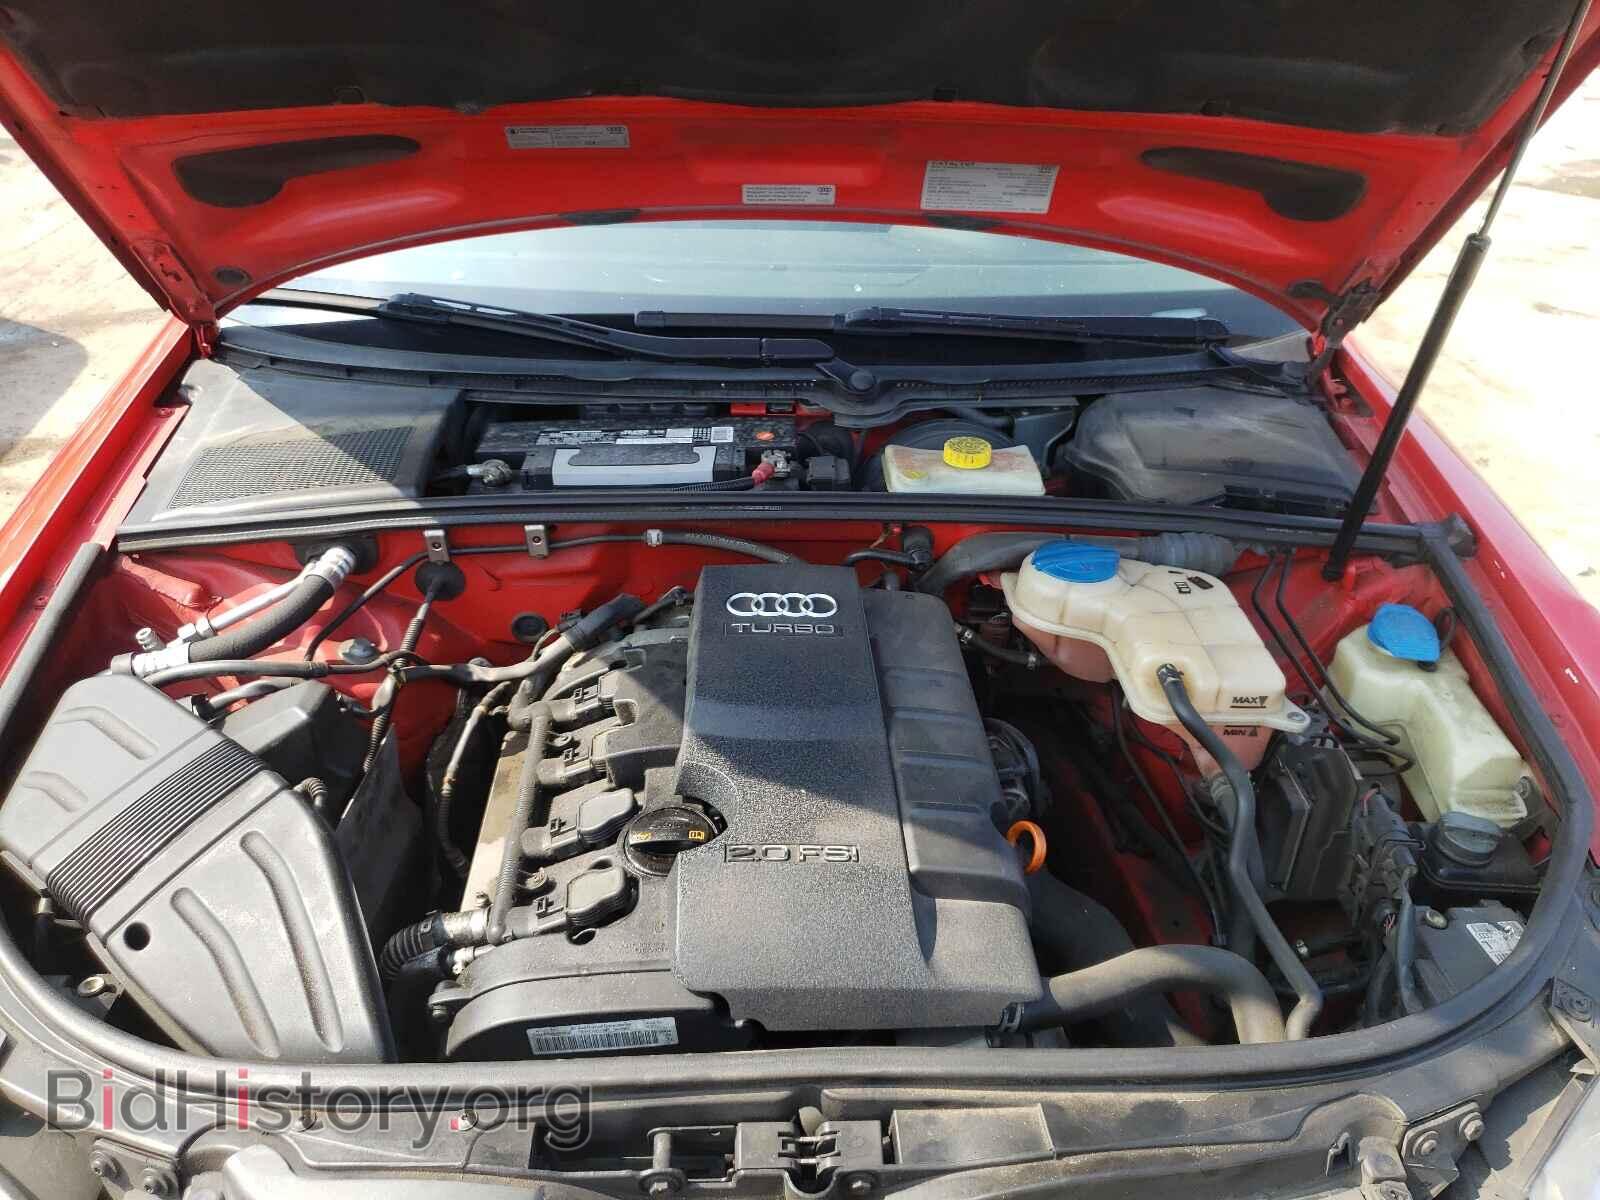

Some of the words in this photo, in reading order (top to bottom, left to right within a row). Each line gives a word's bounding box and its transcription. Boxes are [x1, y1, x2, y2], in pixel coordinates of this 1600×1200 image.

[731, 623, 835, 633] TURBO
[1231, 696, 1258, 704] MAX
[727, 845, 790, 863] 2.0
